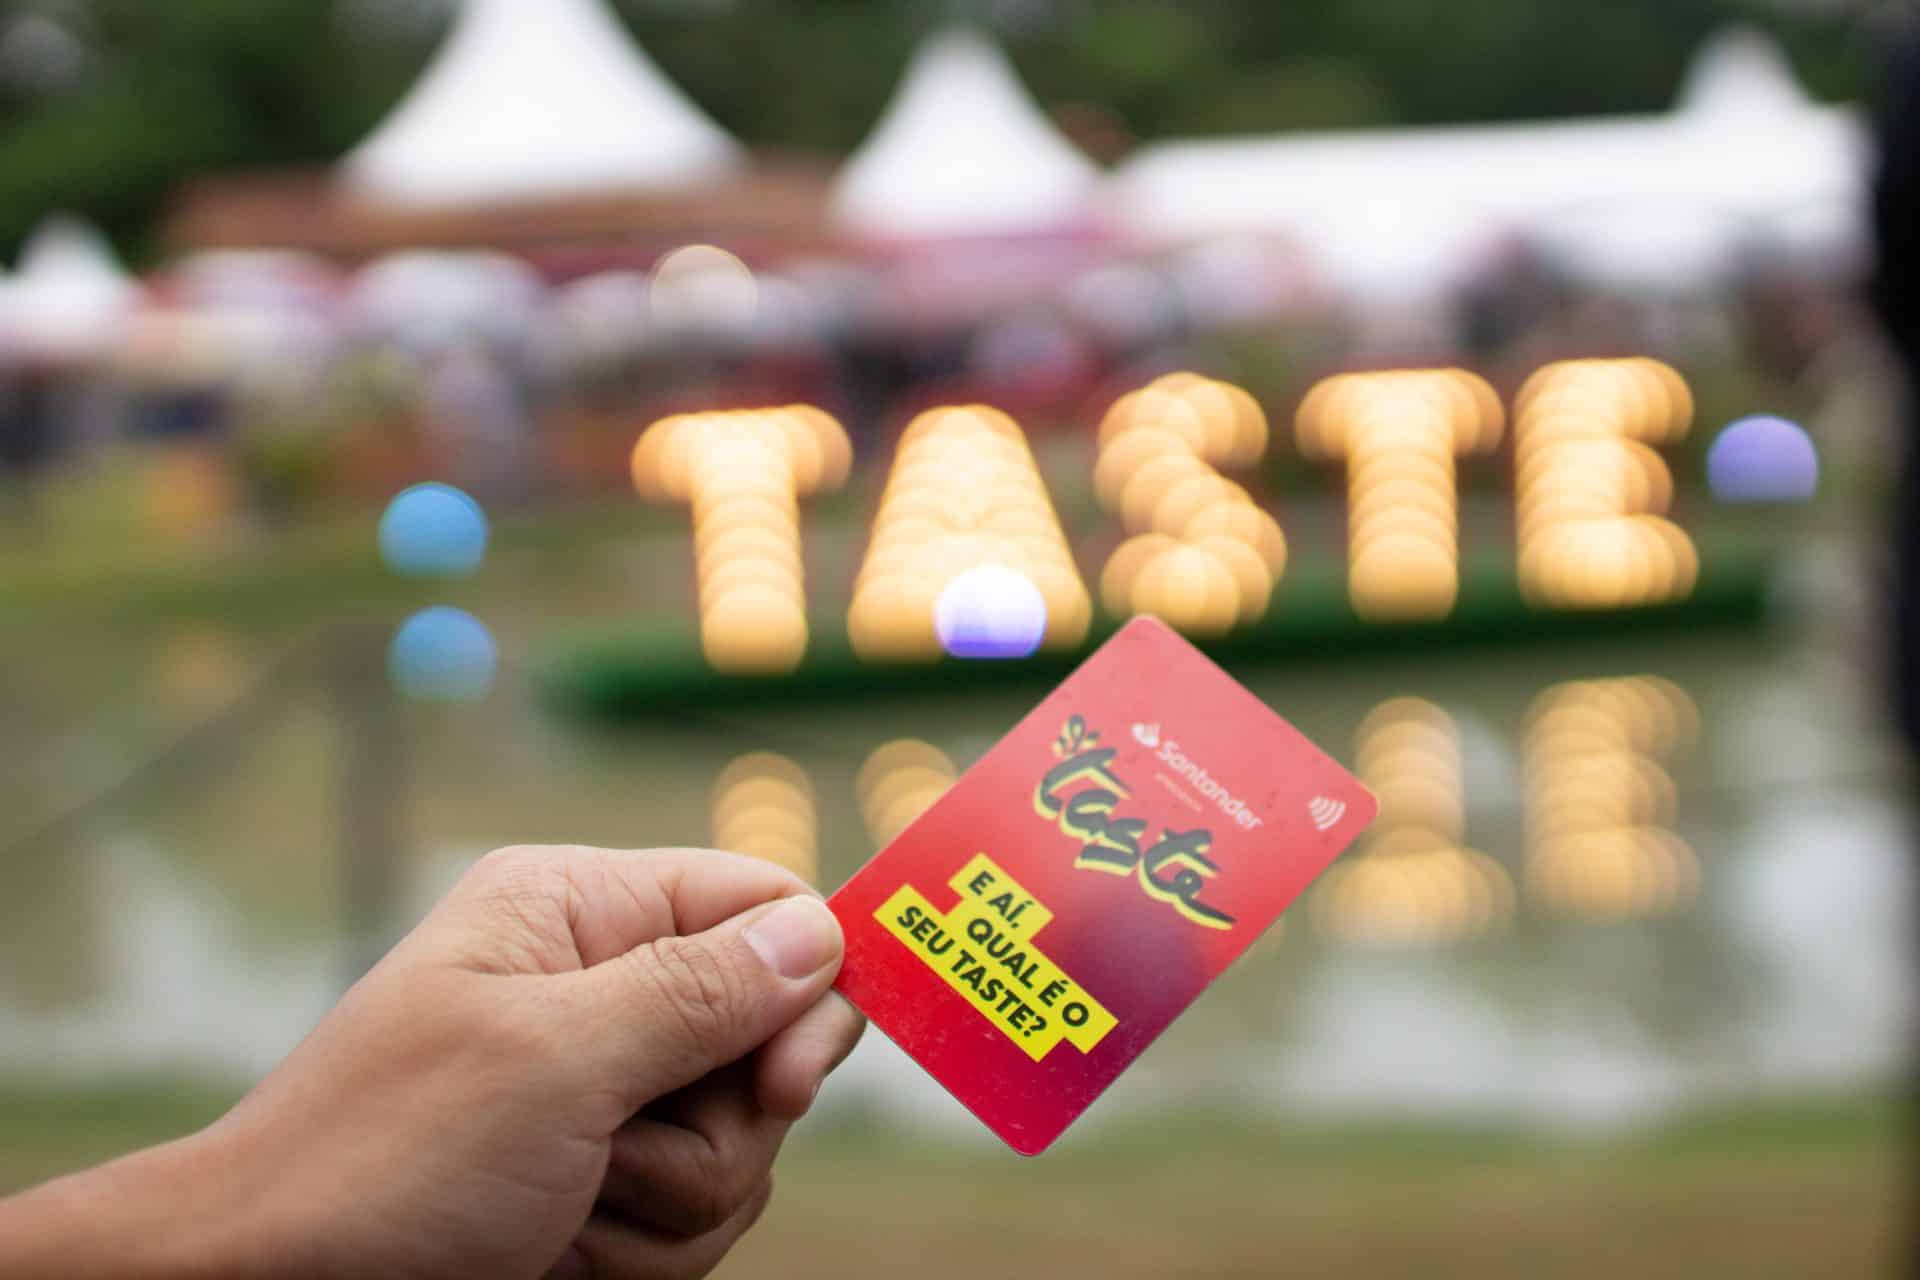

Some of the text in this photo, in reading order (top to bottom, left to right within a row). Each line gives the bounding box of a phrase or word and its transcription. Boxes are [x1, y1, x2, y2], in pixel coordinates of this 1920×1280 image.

[632, 356, 1699, 675] TASTE
[1033, 742, 1238, 931] taste
[1154, 739, 1264, 831] Santander
[967, 870, 1035, 929] E AÍ,
[896, 905, 1048, 1039] SEU TASTE?
[966, 917, 1090, 1028] QUAL É O
